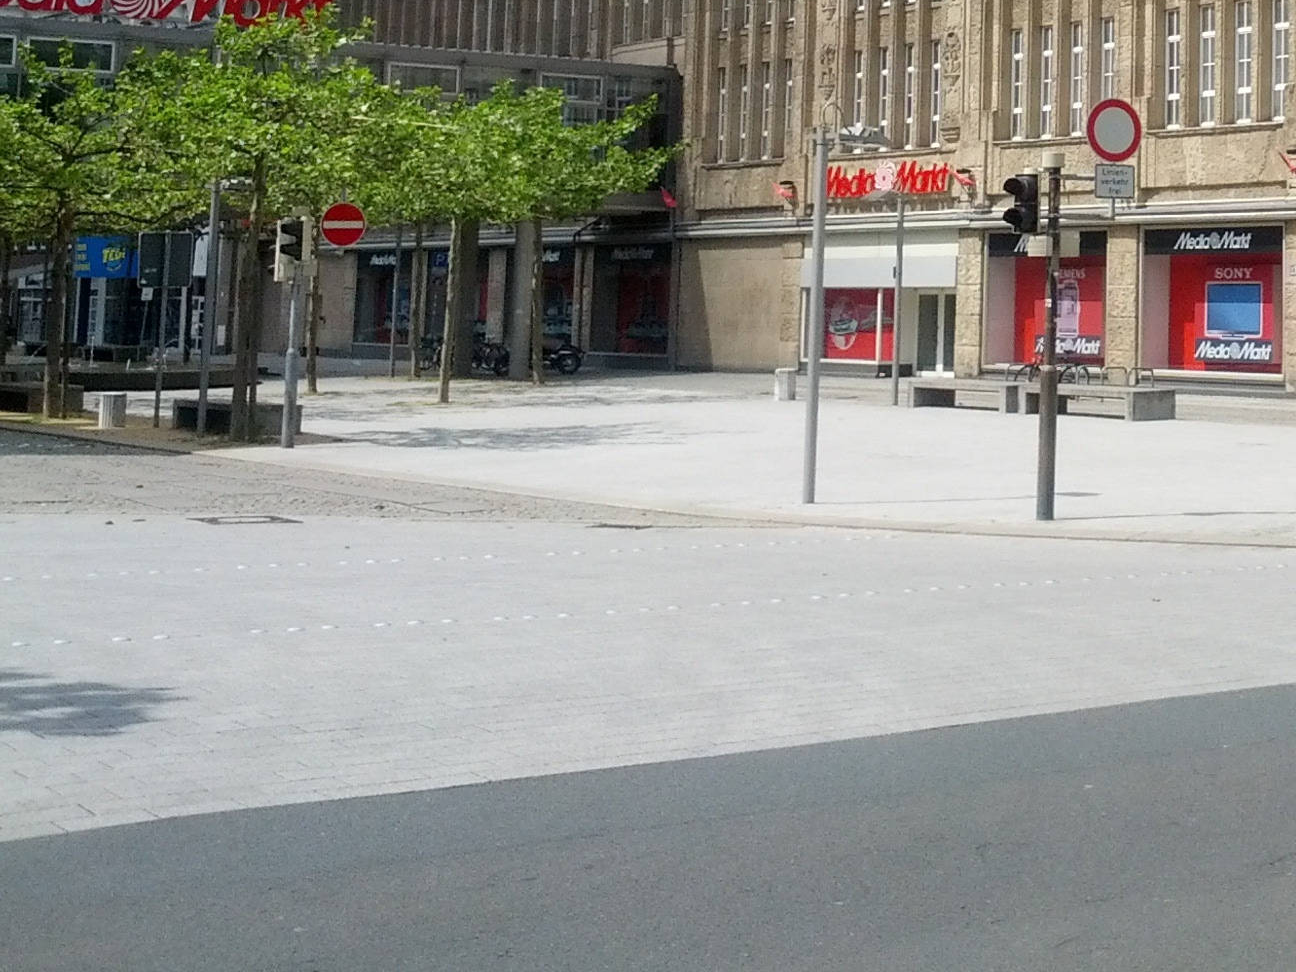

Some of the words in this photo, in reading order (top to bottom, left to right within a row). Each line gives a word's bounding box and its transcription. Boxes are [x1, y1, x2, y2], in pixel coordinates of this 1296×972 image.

[826, 166, 875, 198] Media
[893, 161, 949, 193] Markt
[1174, 232, 1210, 249] Media
[1219, 231, 1252, 248] Markt
[1058, 268, 1086, 279] EMENS
[1214, 268, 1254, 279] SONY
[1035, 336, 1065, 354] Mia
[1073, 337, 1101, 354] Markt
[1194, 341, 1231, 360] Media
[1238, 342, 1272, 360] Markt
